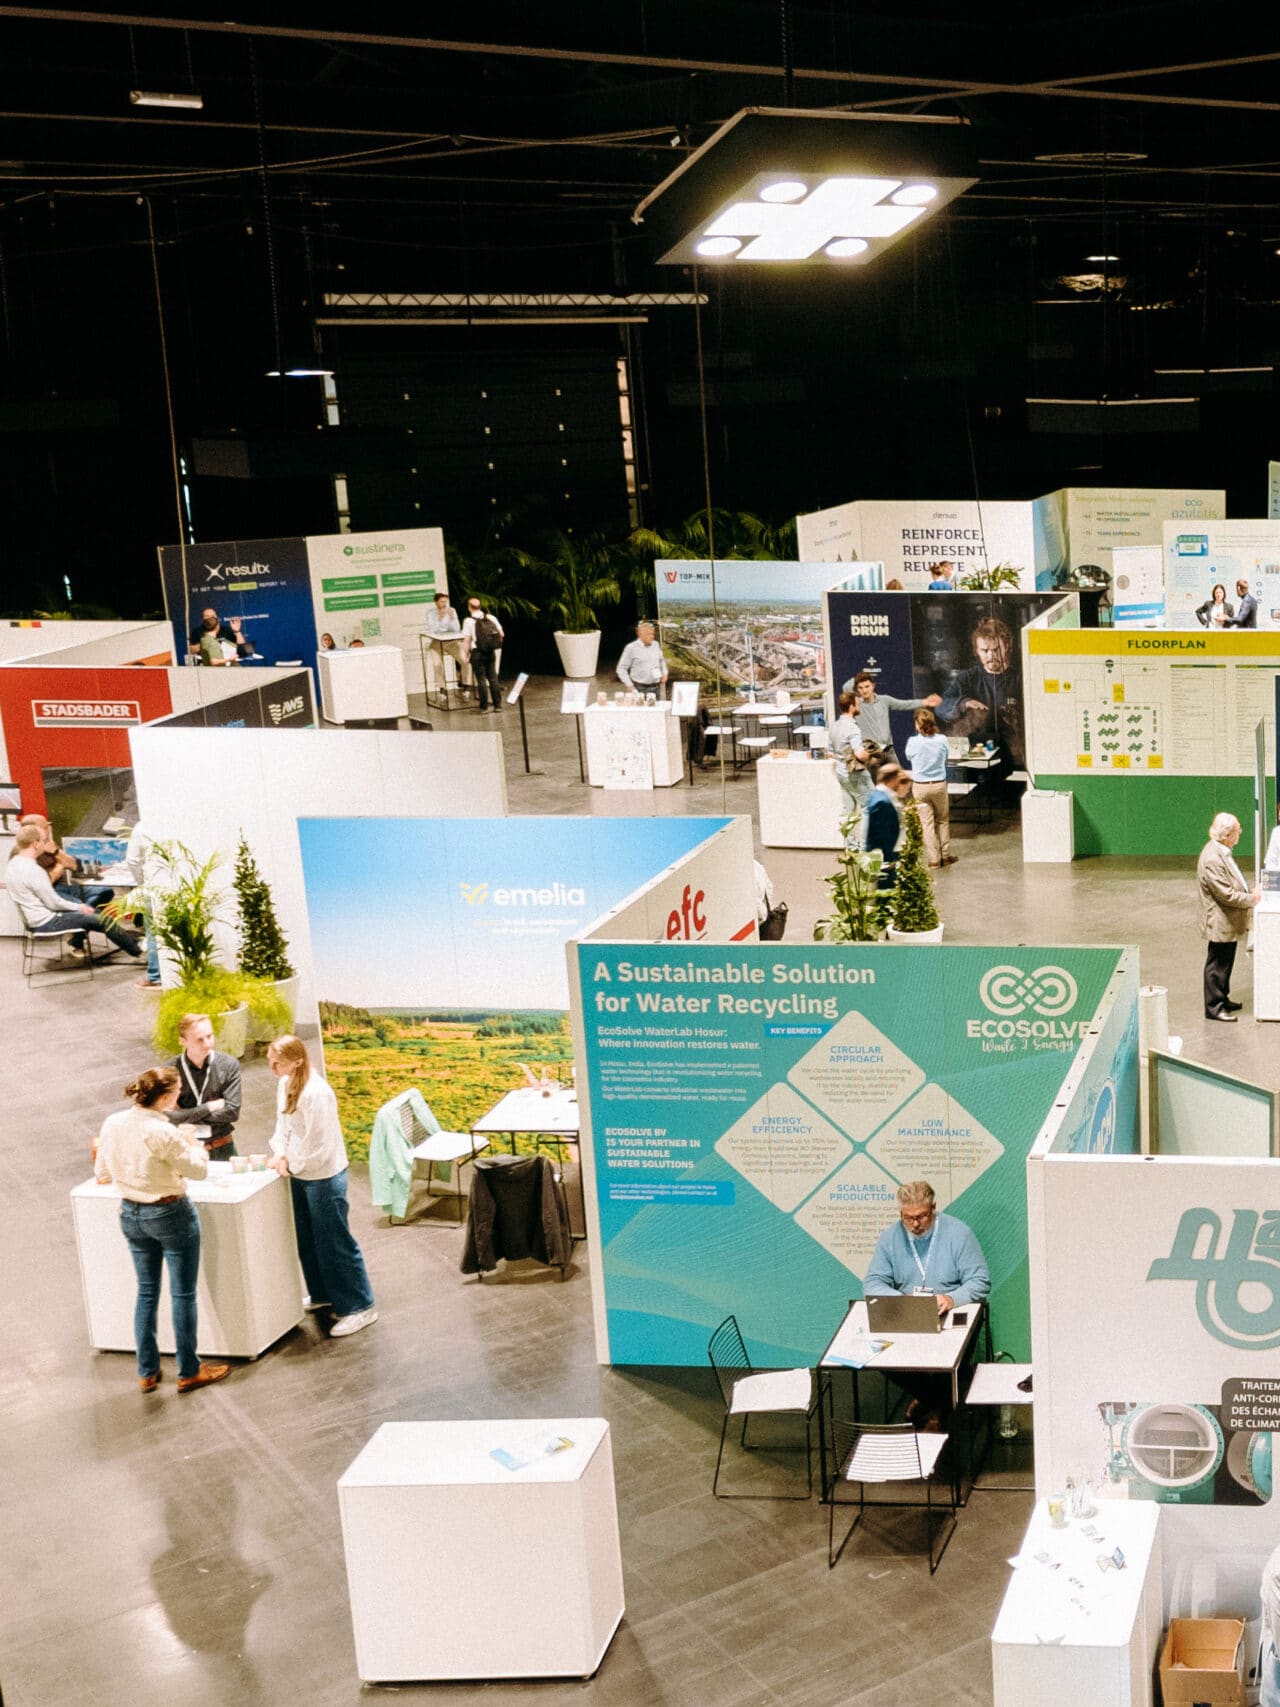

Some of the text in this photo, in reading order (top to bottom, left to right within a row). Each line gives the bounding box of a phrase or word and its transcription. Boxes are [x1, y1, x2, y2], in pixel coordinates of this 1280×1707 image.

[225, 561, 270, 576] resultx
[850, 614, 889, 625] DRUM
[850, 625, 890, 636] DRUM
[1127, 639, 1206, 649] FLOORPLAN
[42, 703, 131, 717] STADSBADER
[493, 882, 586, 906] emelia
[594, 961, 876, 984] A Sustainable Solution
[595, 991, 839, 1019] for Water Recycling
[598, 1026, 728, 1037] EcoSolve WaterLab Hosur:
[770, 1027, 822, 1035] KEY BENEFITS
[598, 1038, 761, 1050] Where innovation restores water.
[1033, 1035, 1074, 1053] Energy
[830, 1045, 881, 1054] CIRCULAR
[829, 1055, 884, 1063] APPROACH
[761, 1116, 802, 1125] ENERGY
[921, 1119, 944, 1128] LOW
[605, 1128, 667, 1136] ECOSOLVE BV
[752, 1125, 813, 1134] EFFICIENCY
[897, 1128, 972, 1137] MAINTENANCE
[606, 1138, 701, 1148] IS YOUR PARTNER IN
[607, 1149, 671, 1158] SUSTAINABLE
[608, 1160, 695, 1169] WATER SOLUTIONS
[837, 1184, 887, 1192] SCALABLE
[829, 1192, 895, 1201] PRODUCTION
[1231, 1406, 1250, 1416] DES
[1231, 1419, 1244, 1428] DE
